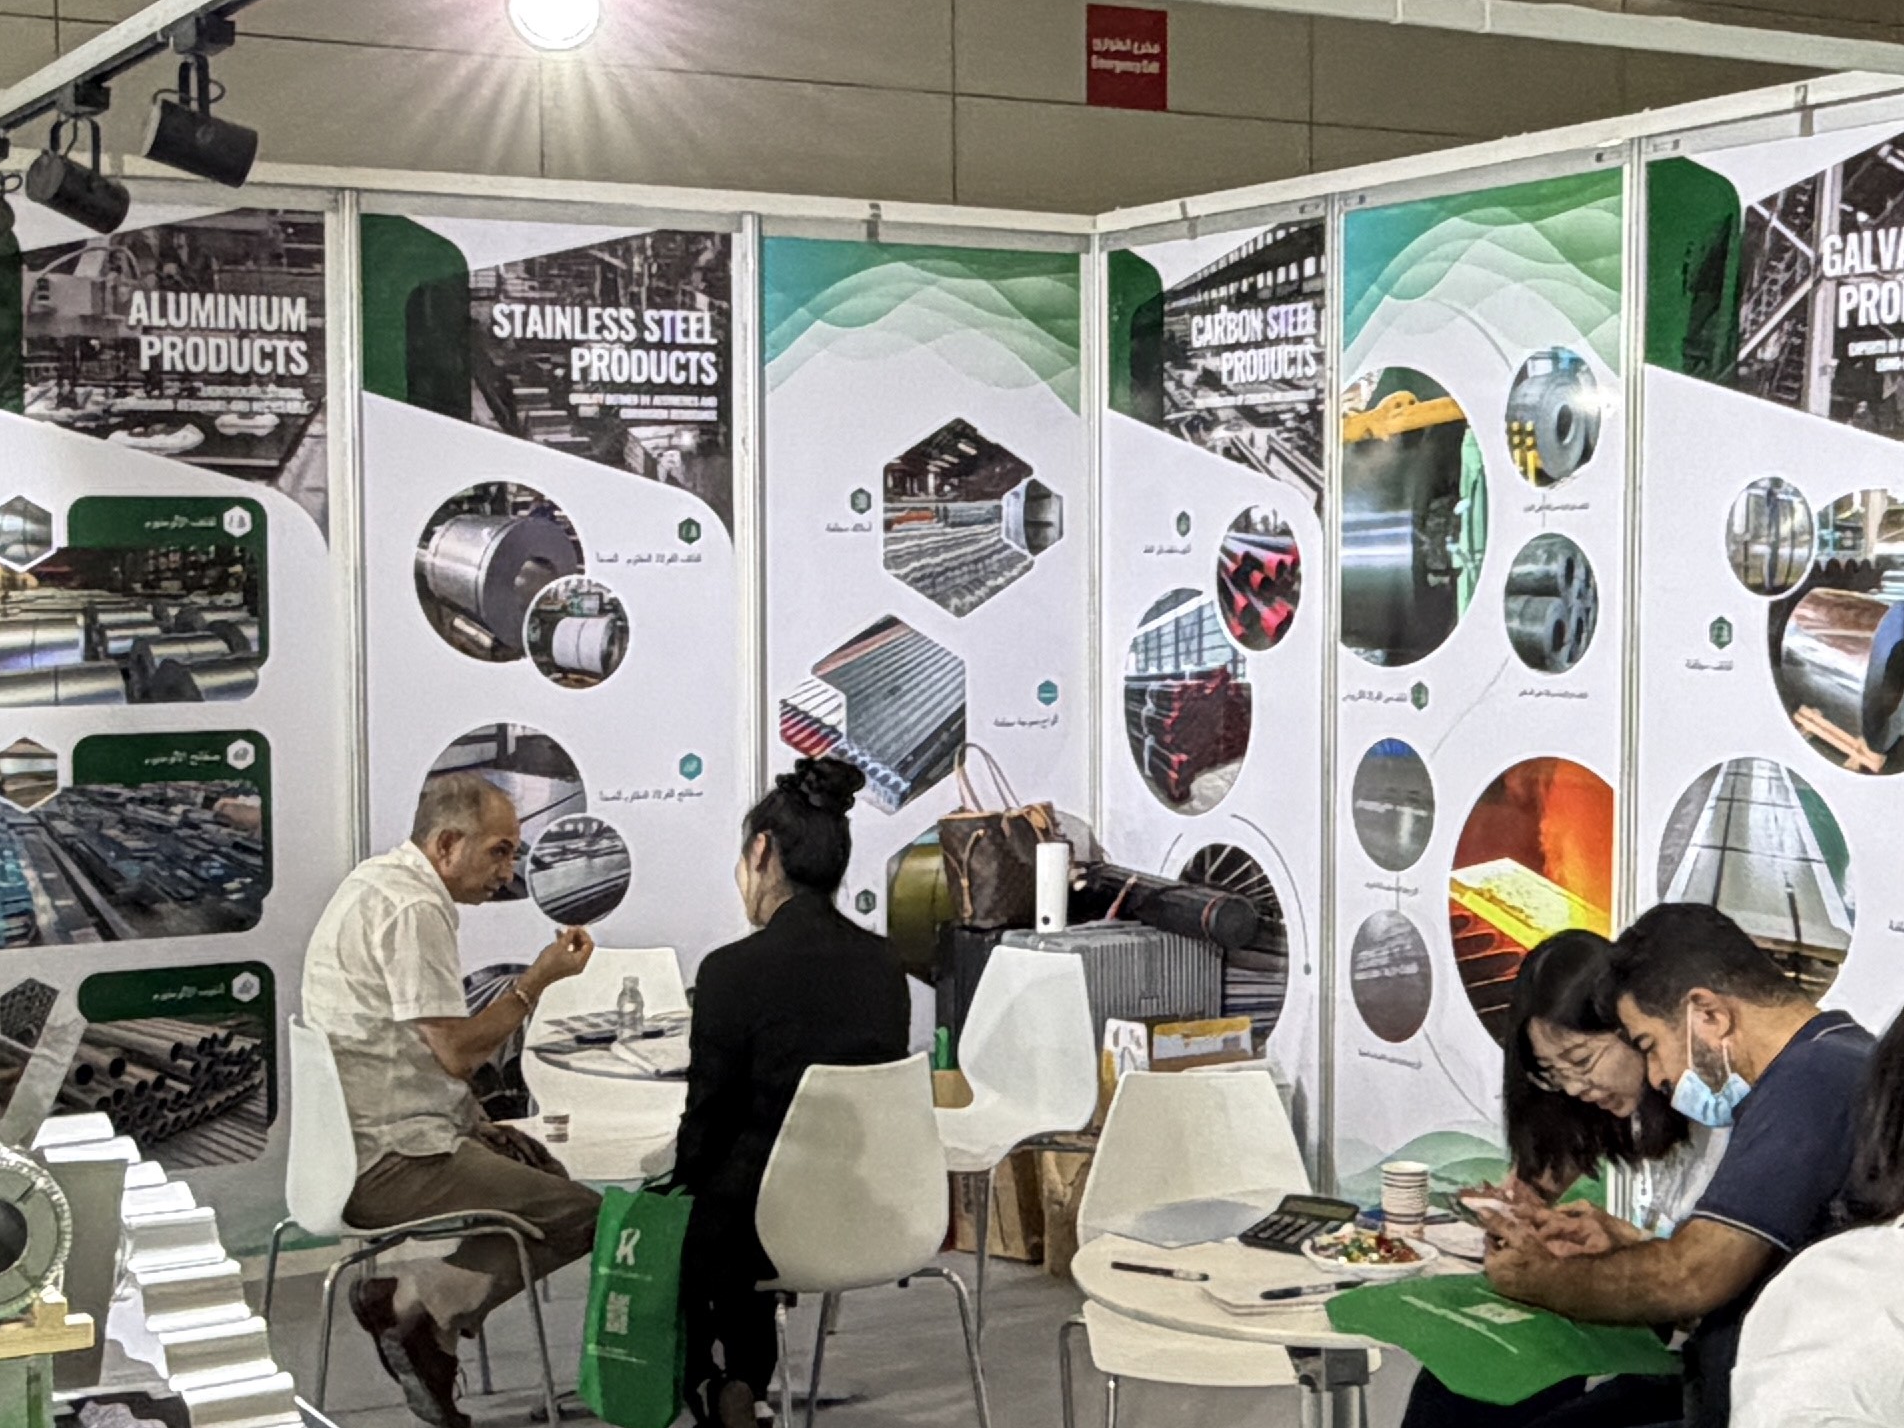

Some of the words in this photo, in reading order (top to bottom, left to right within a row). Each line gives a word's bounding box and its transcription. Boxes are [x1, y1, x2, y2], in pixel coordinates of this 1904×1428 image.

[127, 290, 308, 333] ALUMINIUM
[492, 303, 637, 342] STAINLESS
[643, 309, 718, 345] STEEL
[1191, 306, 1264, 348] CARBON
[1266, 301, 1317, 340] STEEL
[139, 335, 309, 376] PRODUCTS
[570, 347, 718, 386] PRODUCTS
[1221, 343, 1317, 385] PRODUCTS
